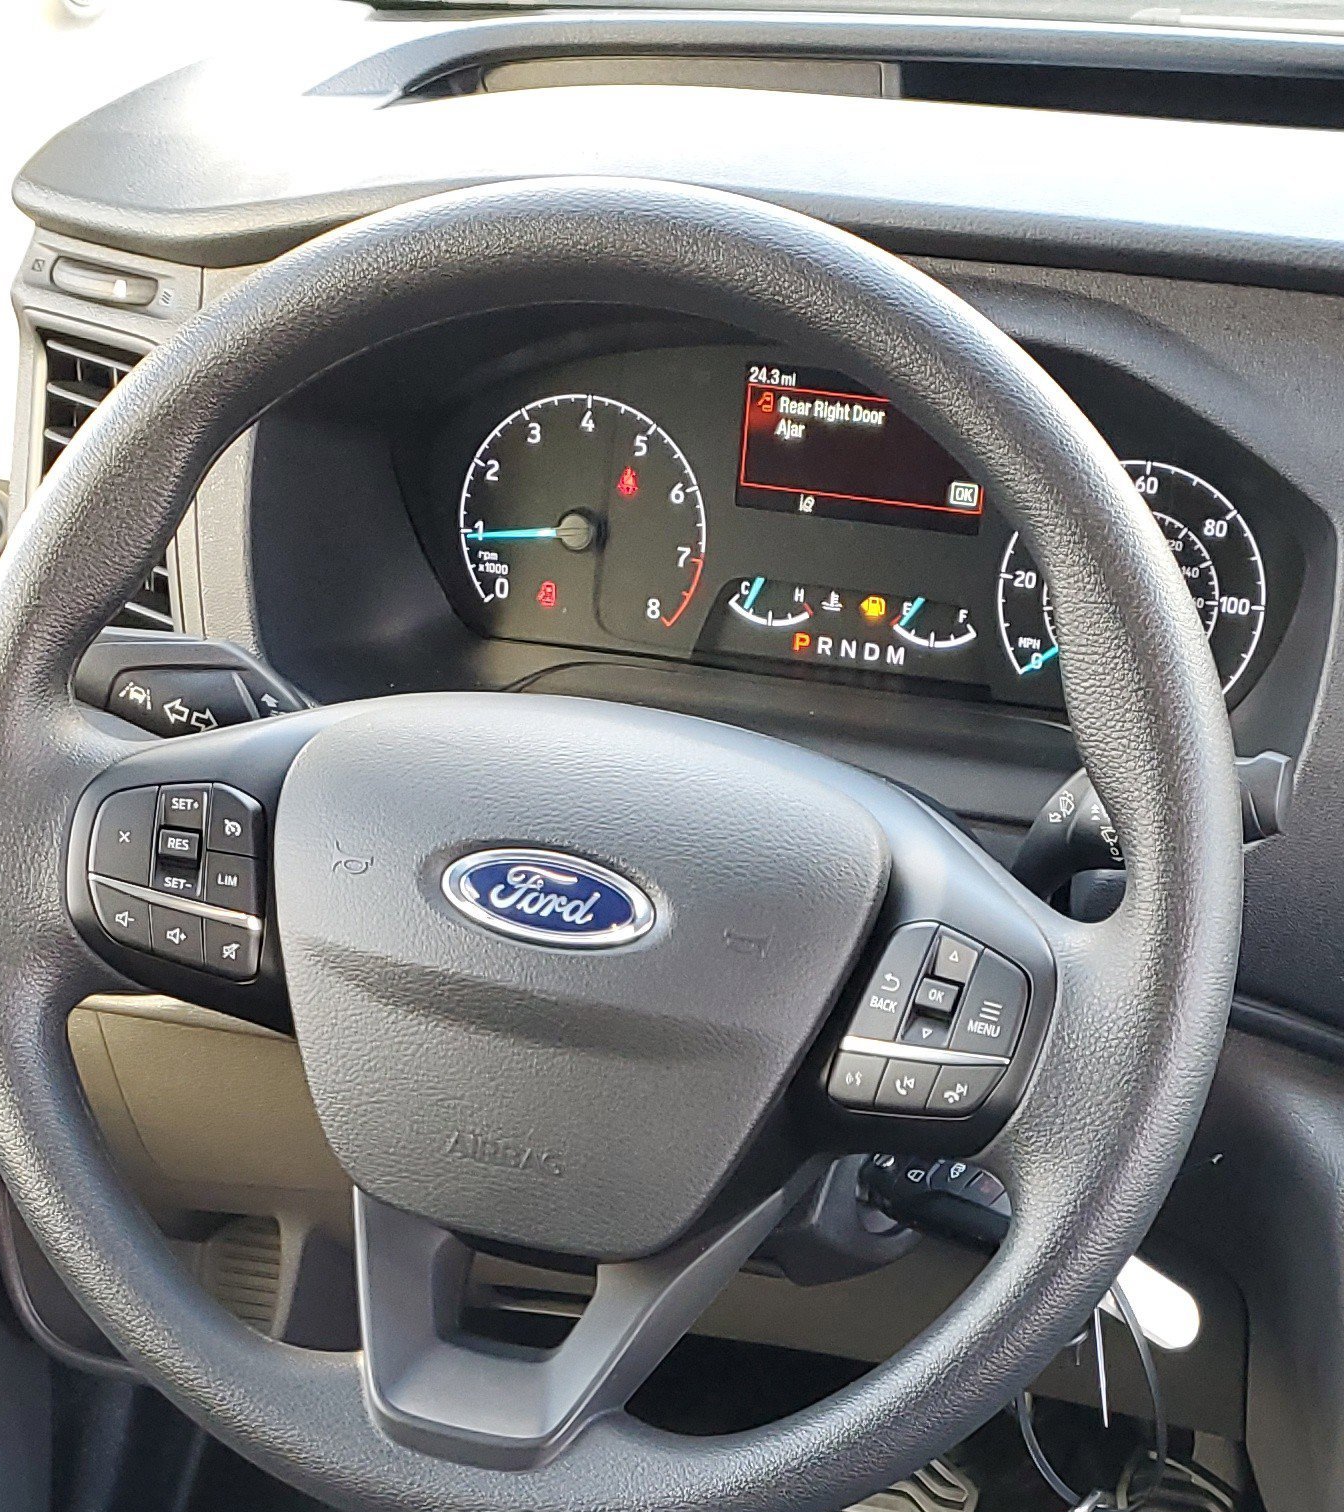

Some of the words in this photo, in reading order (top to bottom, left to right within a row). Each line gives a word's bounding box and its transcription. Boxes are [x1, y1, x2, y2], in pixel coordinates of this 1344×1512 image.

[749, 366, 779, 385] 24.3
[780, 396, 811, 416] Rear
[813, 400, 849, 421] Right
[852, 405, 885, 424] Door
[581, 411, 595, 432] 4
[775, 418, 805, 439] Ajar
[527, 422, 541, 444] 3
[634, 436, 647, 457] 5
[486, 460, 499, 481] 2
[670, 483, 684, 504] 6
[955, 487, 973, 502] OK
[1135, 476, 1158, 494] 60
[474, 520, 484, 541] 1
[1204, 519, 1227, 538] 80
[1166, 540, 1183, 552] 20
[478, 551, 498, 561] rpm
[677, 547, 691, 567] 7
[495, 577, 509, 598] 0
[740, 581, 750, 595] C
[1013, 570, 1037, 589] 20
[794, 587, 805, 602] H
[646, 598, 660, 619] 8
[902, 602, 911, 616] E
[1219, 596, 1250, 615] 100
[958, 609, 968, 623] F
[794, 633, 810, 651] P
[817, 637, 832, 655] R
[840, 640, 856, 659] N
[863, 643, 879, 661] D
[886, 646, 904, 665] M
[1017, 636, 1041, 650] MPH
[1031, 652, 1043, 669] 0
[167, 837, 190, 851] RES
[217, 873, 238, 887] LIM
[490, 865, 598, 925] Ford
[870, 995, 899, 1014] BACK
[928, 988, 945, 1003] OK
[968, 1019, 1001, 1039] MENU
